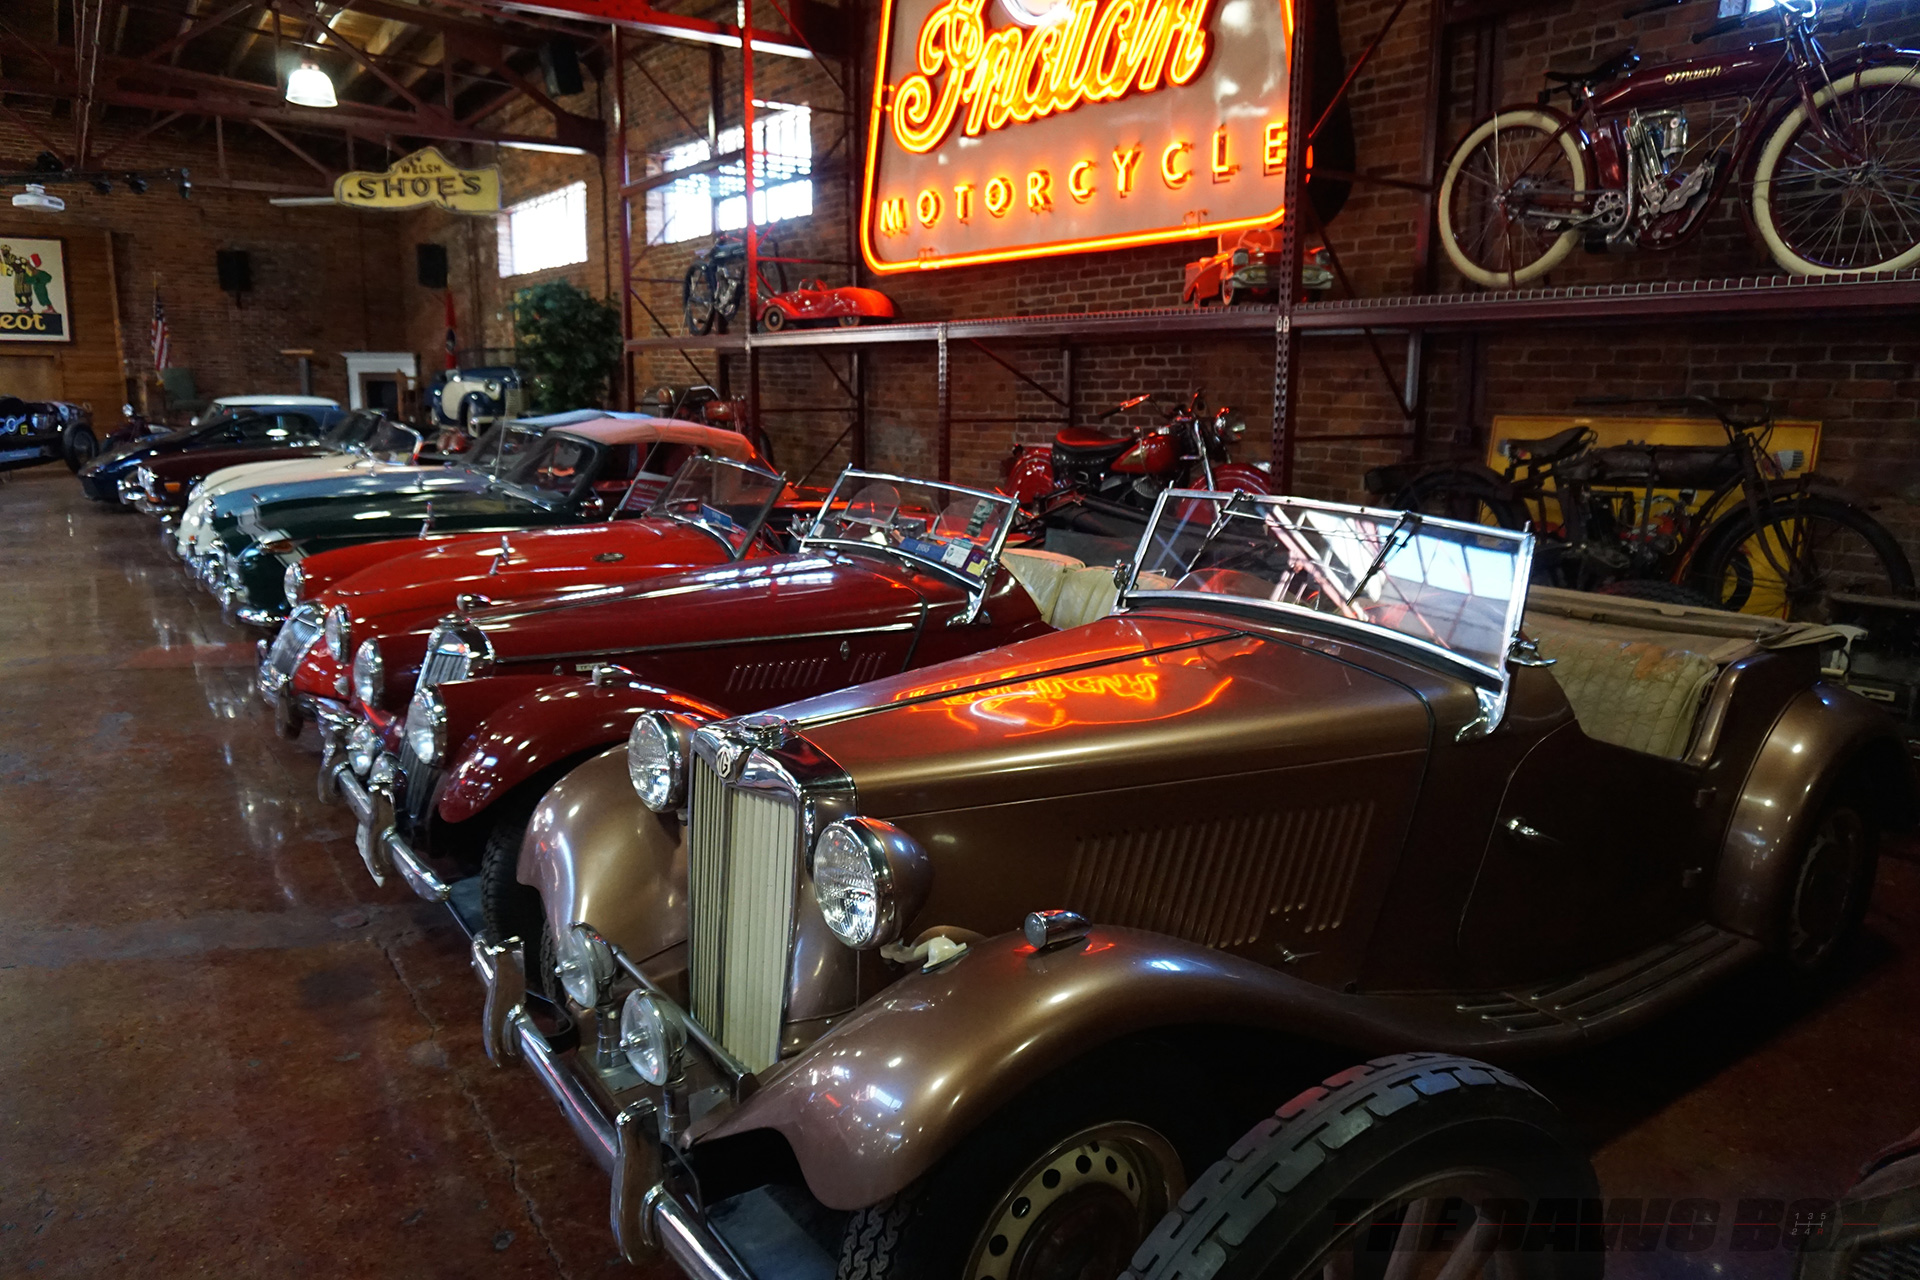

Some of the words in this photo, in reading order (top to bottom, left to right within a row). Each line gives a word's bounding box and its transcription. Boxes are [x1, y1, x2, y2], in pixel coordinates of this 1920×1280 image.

[891, 0, 1214, 154] Indian
[357, 176, 482, 199] SHOES
[880, 121, 1288, 235] MOTORCYCLE
